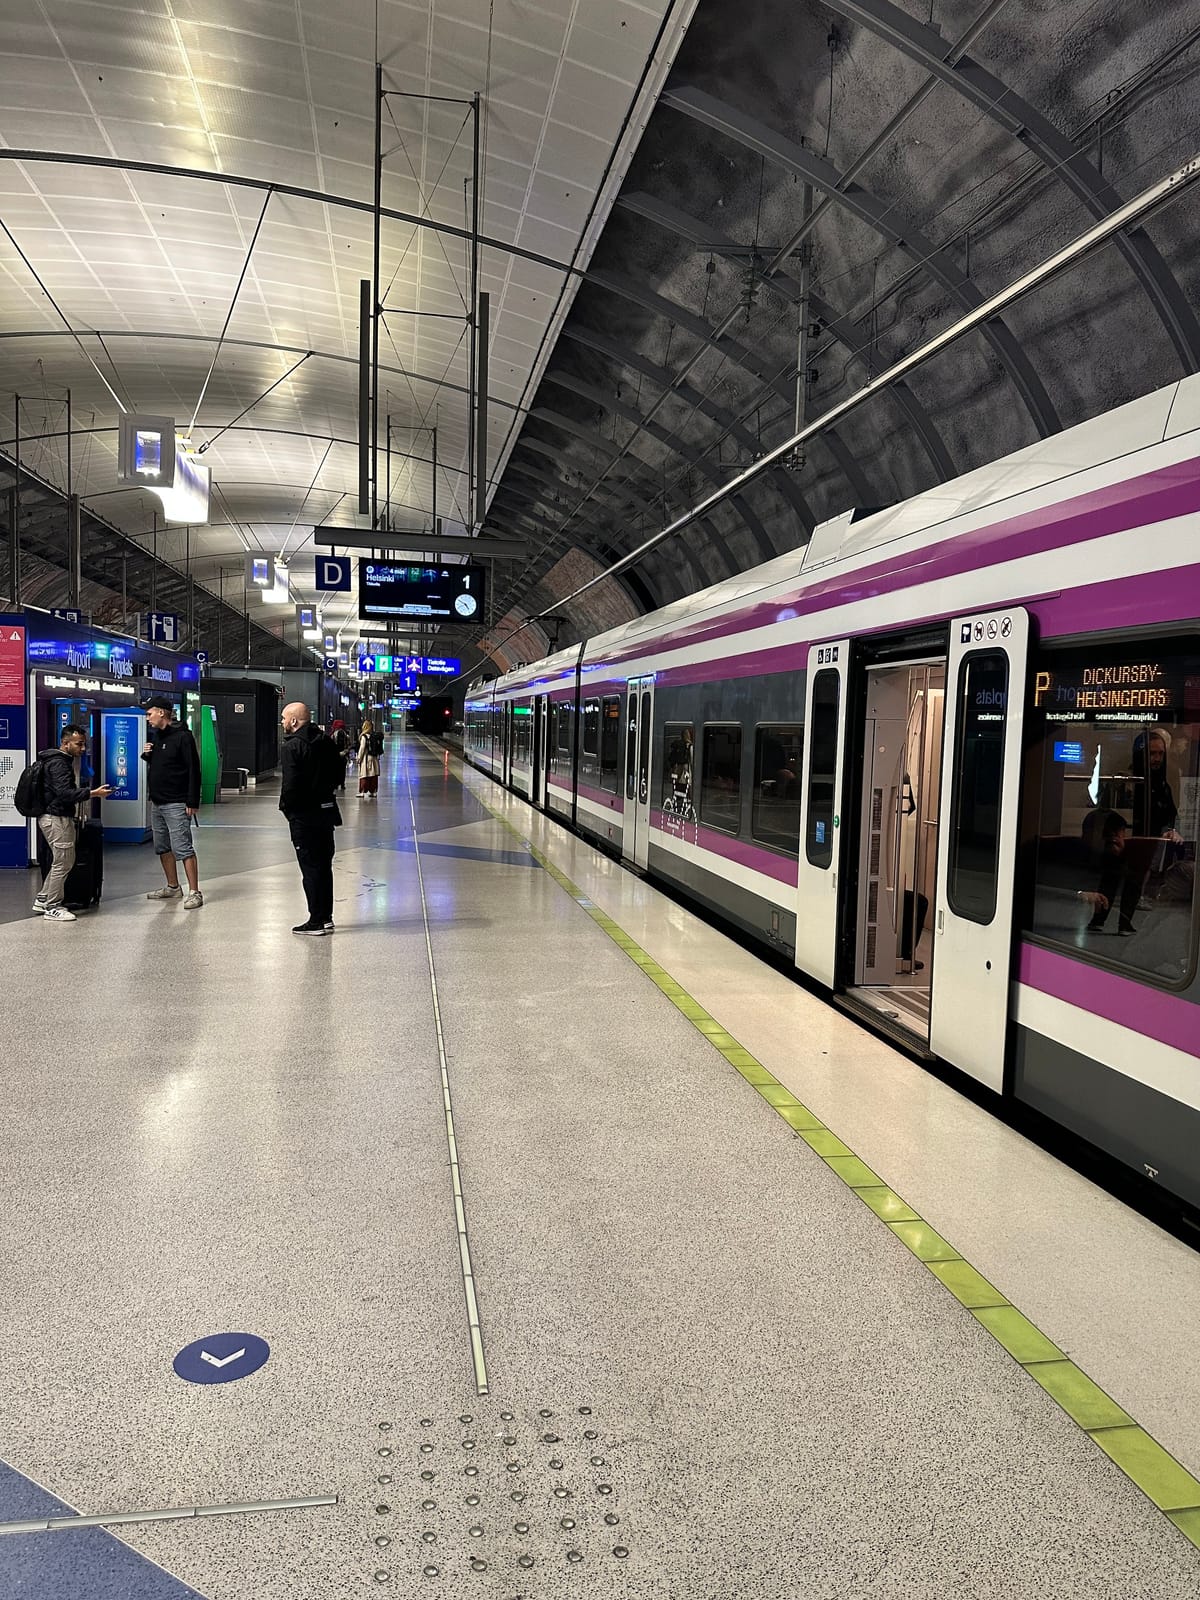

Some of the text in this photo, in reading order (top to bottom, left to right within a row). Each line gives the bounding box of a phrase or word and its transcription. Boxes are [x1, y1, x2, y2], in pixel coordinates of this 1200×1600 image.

[323, 562, 343, 585] D
[366, 574, 395, 583] Helsinki
[462, 575, 470, 590] 1
[67, 645, 91, 672] Airport
[109, 655, 133, 679] Flygplats
[196, 652, 206, 663] C
[326, 658, 335, 669] C
[404, 676, 411, 688] 1
[1083, 664, 1165, 685] DICKURSBY-
[1034, 672, 1050, 707] P
[1076, 688, 1167, 708] HELSINGFORS
